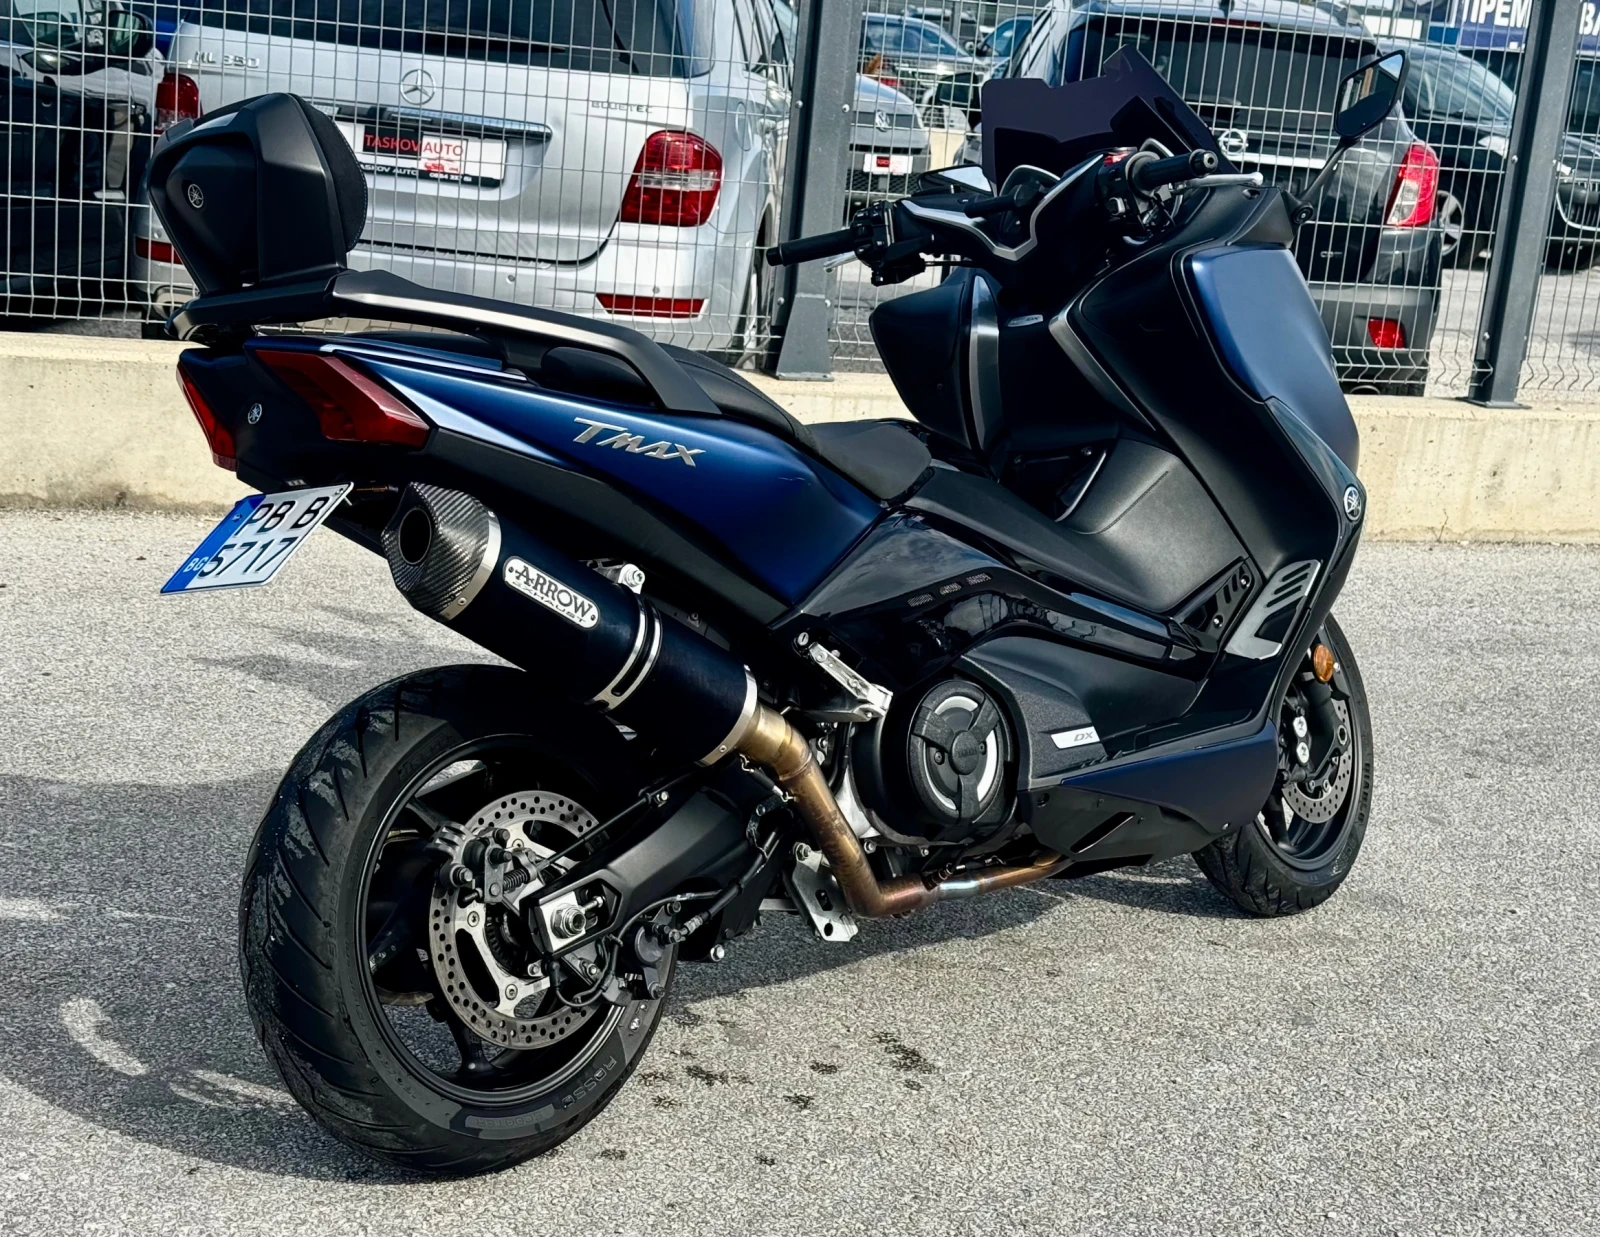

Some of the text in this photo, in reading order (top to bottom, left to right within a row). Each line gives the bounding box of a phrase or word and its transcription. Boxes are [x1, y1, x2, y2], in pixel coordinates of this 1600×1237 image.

[223, 54, 260, 69] 350
[365, 134, 464, 156] TASKOV AUTO
[573, 417, 706, 467] TMAX
[234, 496, 330, 536] PB B
[183, 556, 209, 573] BG
[198, 537, 299, 578] 5717
[515, 565, 593, 618] ARROW
[1073, 731, 1094, 742] DX
[561, 1055, 618, 1109] ROSSO
